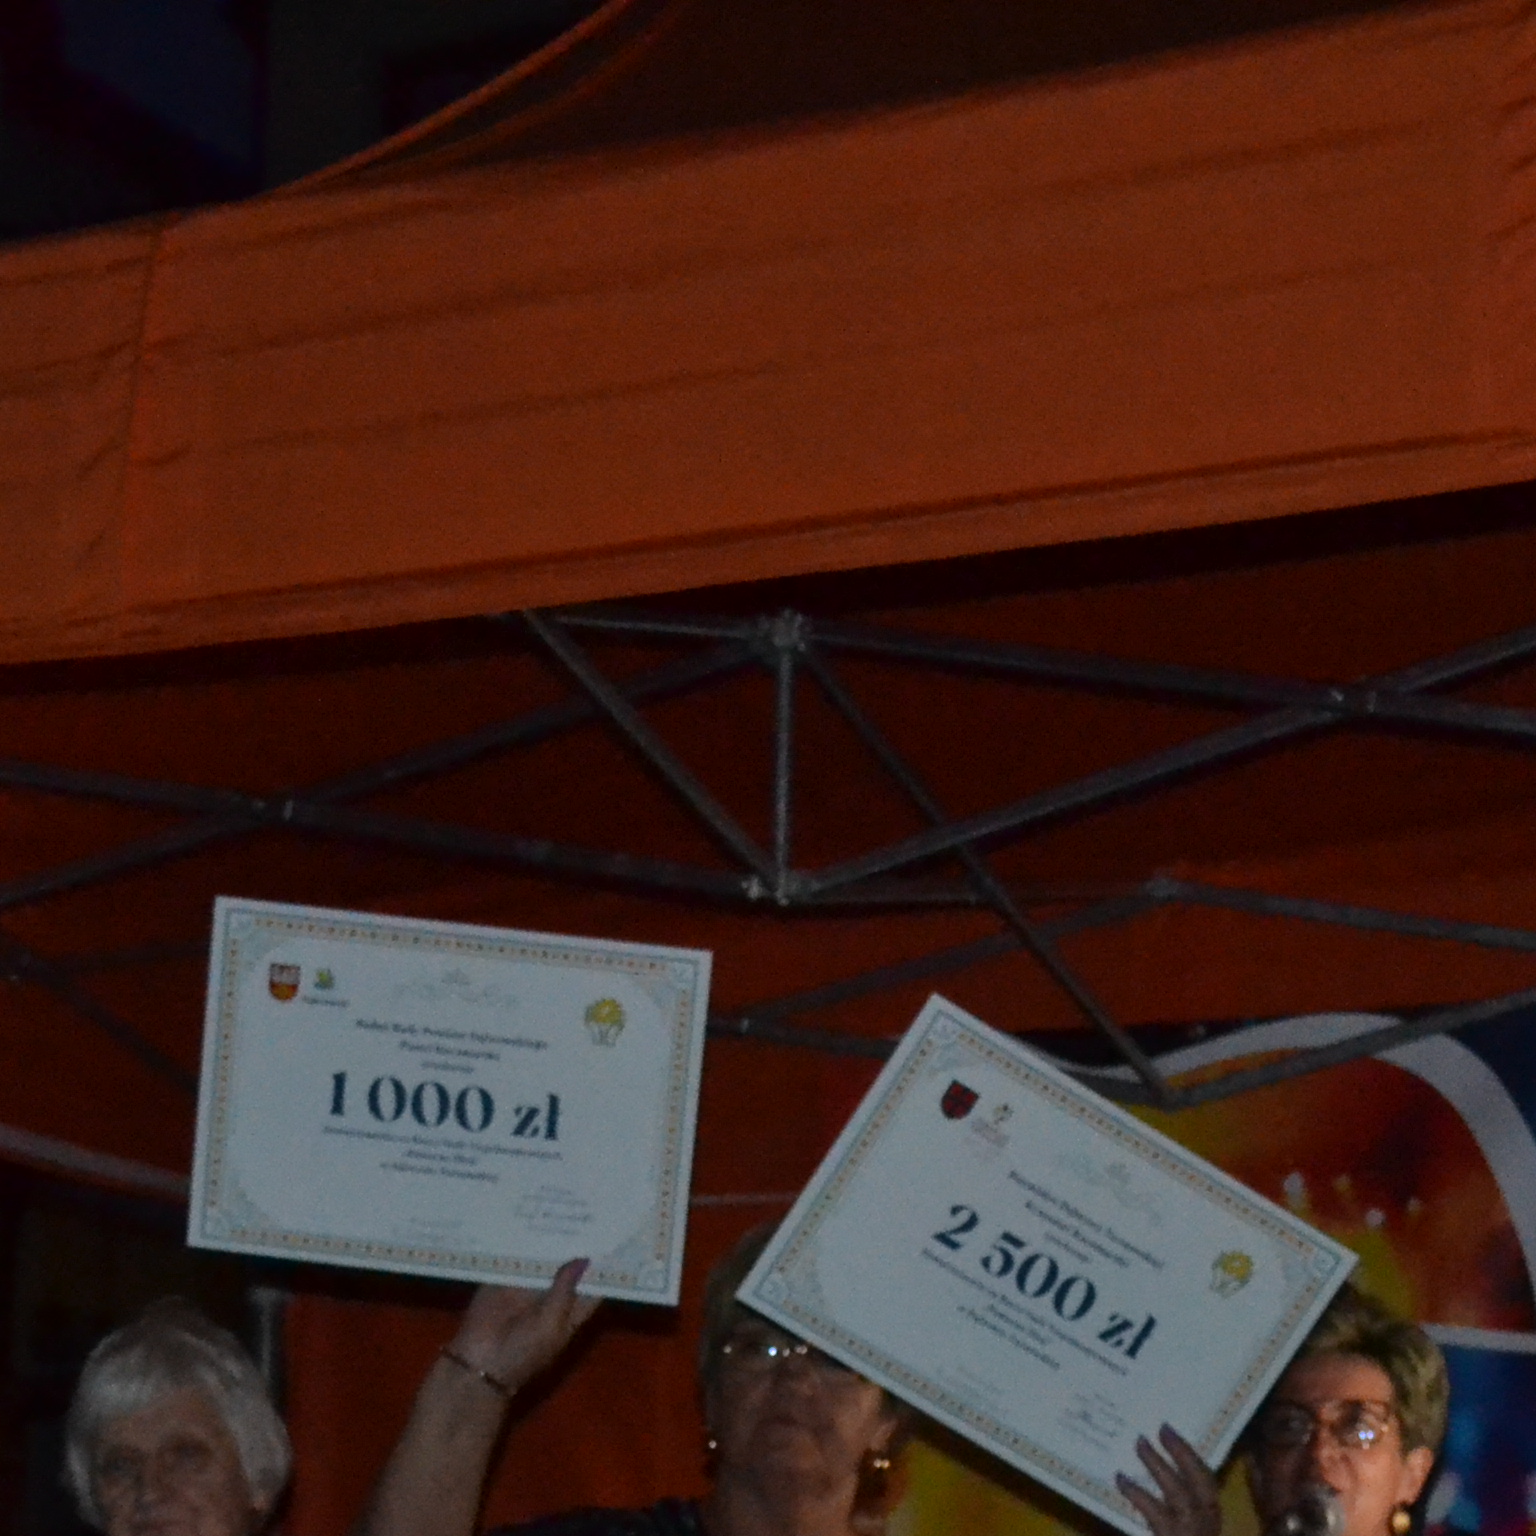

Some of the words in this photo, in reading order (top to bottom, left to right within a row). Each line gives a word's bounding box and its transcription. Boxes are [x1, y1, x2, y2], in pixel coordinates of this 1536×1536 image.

[328, 1070, 348, 1117] 1
[366, 1074, 496, 1133] 000
[930, 1203, 980, 1252] 2
[980, 1229, 1098, 1324] 500
